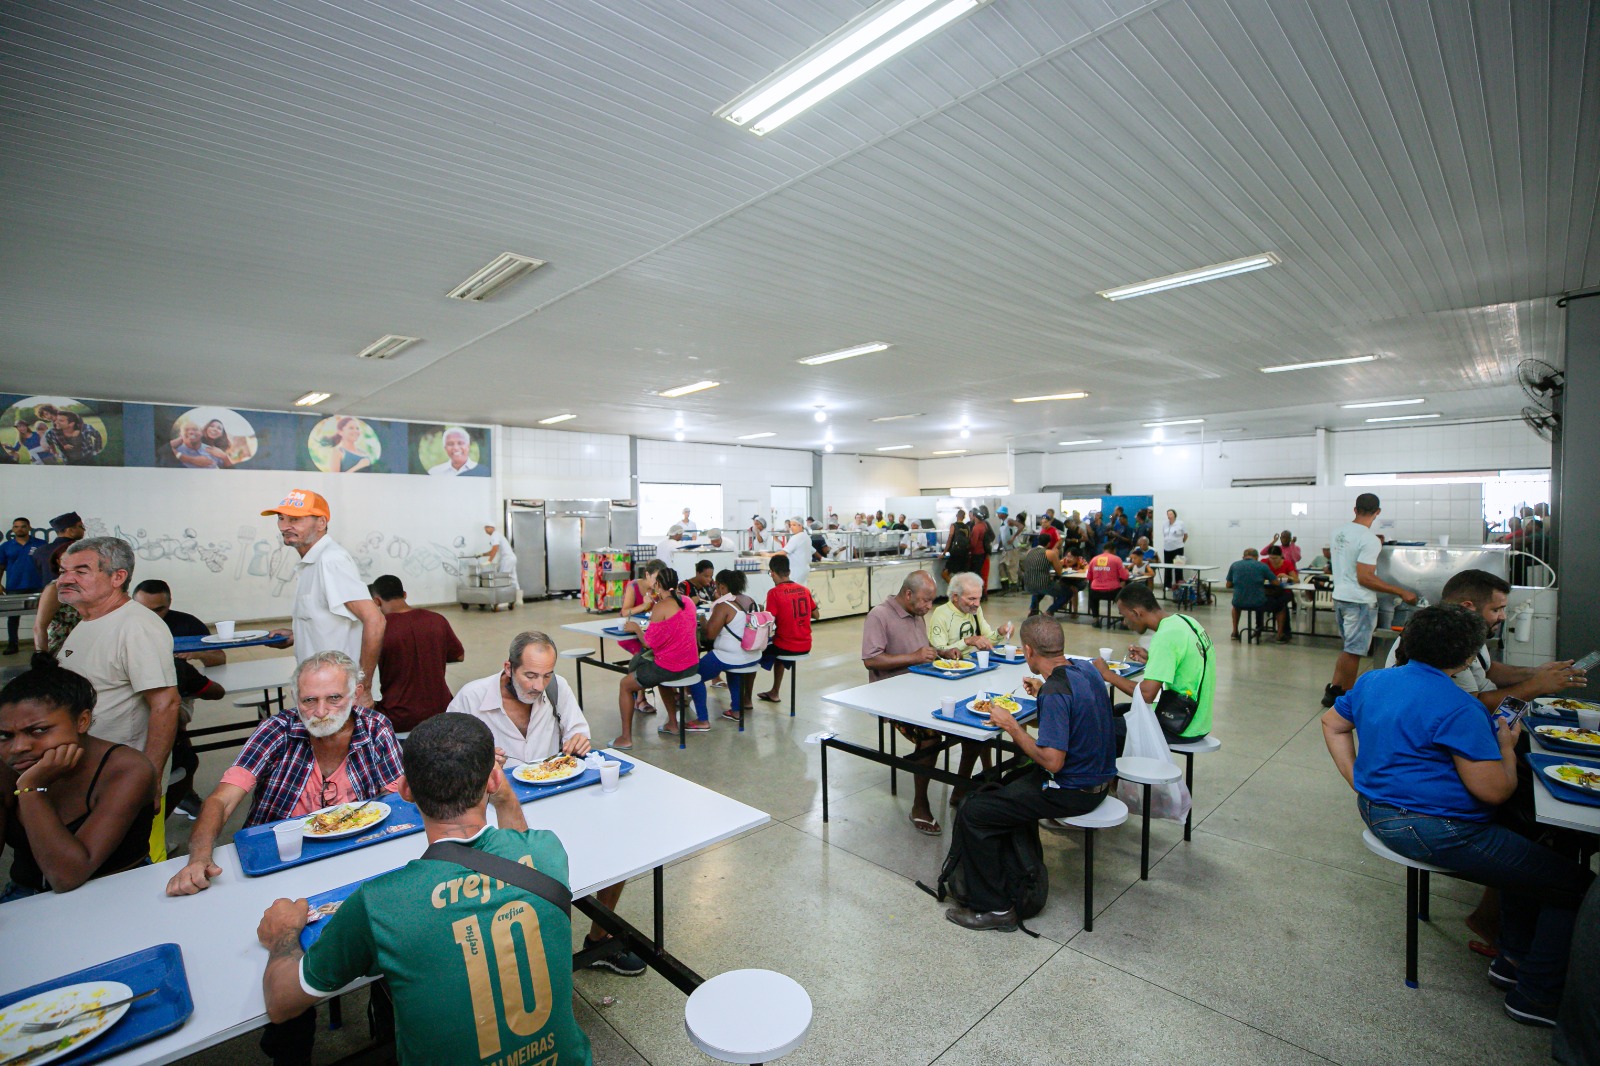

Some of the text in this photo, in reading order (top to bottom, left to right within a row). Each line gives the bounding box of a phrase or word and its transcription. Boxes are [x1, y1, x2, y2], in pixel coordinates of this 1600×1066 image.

[792, 597, 808, 619] 10
[497, 906, 525, 922] crefisa
[465, 924, 479, 955] crefisa
[452, 900, 552, 1060] 10
